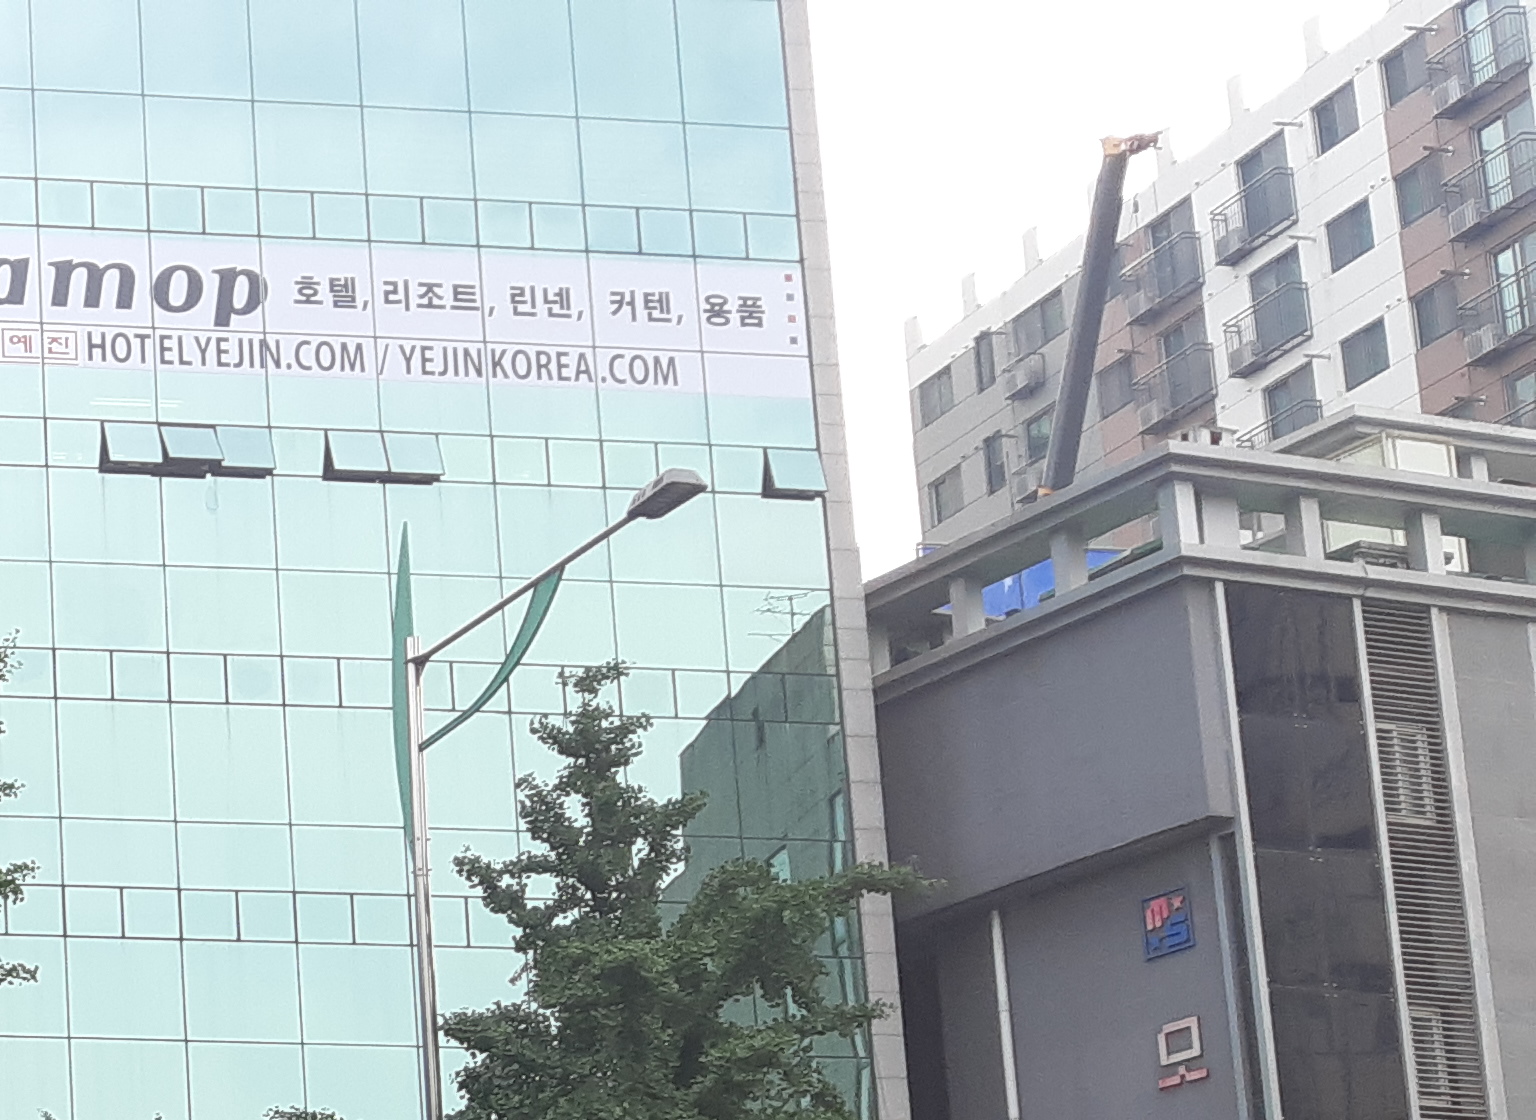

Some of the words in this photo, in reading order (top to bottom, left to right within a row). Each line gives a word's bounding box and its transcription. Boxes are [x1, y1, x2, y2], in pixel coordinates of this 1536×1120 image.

[293, 276, 370, 312] 호텔,
[382, 277, 496, 318] 리조트,
[509, 285, 585, 322] 린넨,
[609, 288, 685, 326] 커텐,
[703, 293, 767, 328] 용품
[86, 330, 366, 374] HOTELYEJIN.COM
[398, 344, 680, 387] YEJINKOREA.COM
